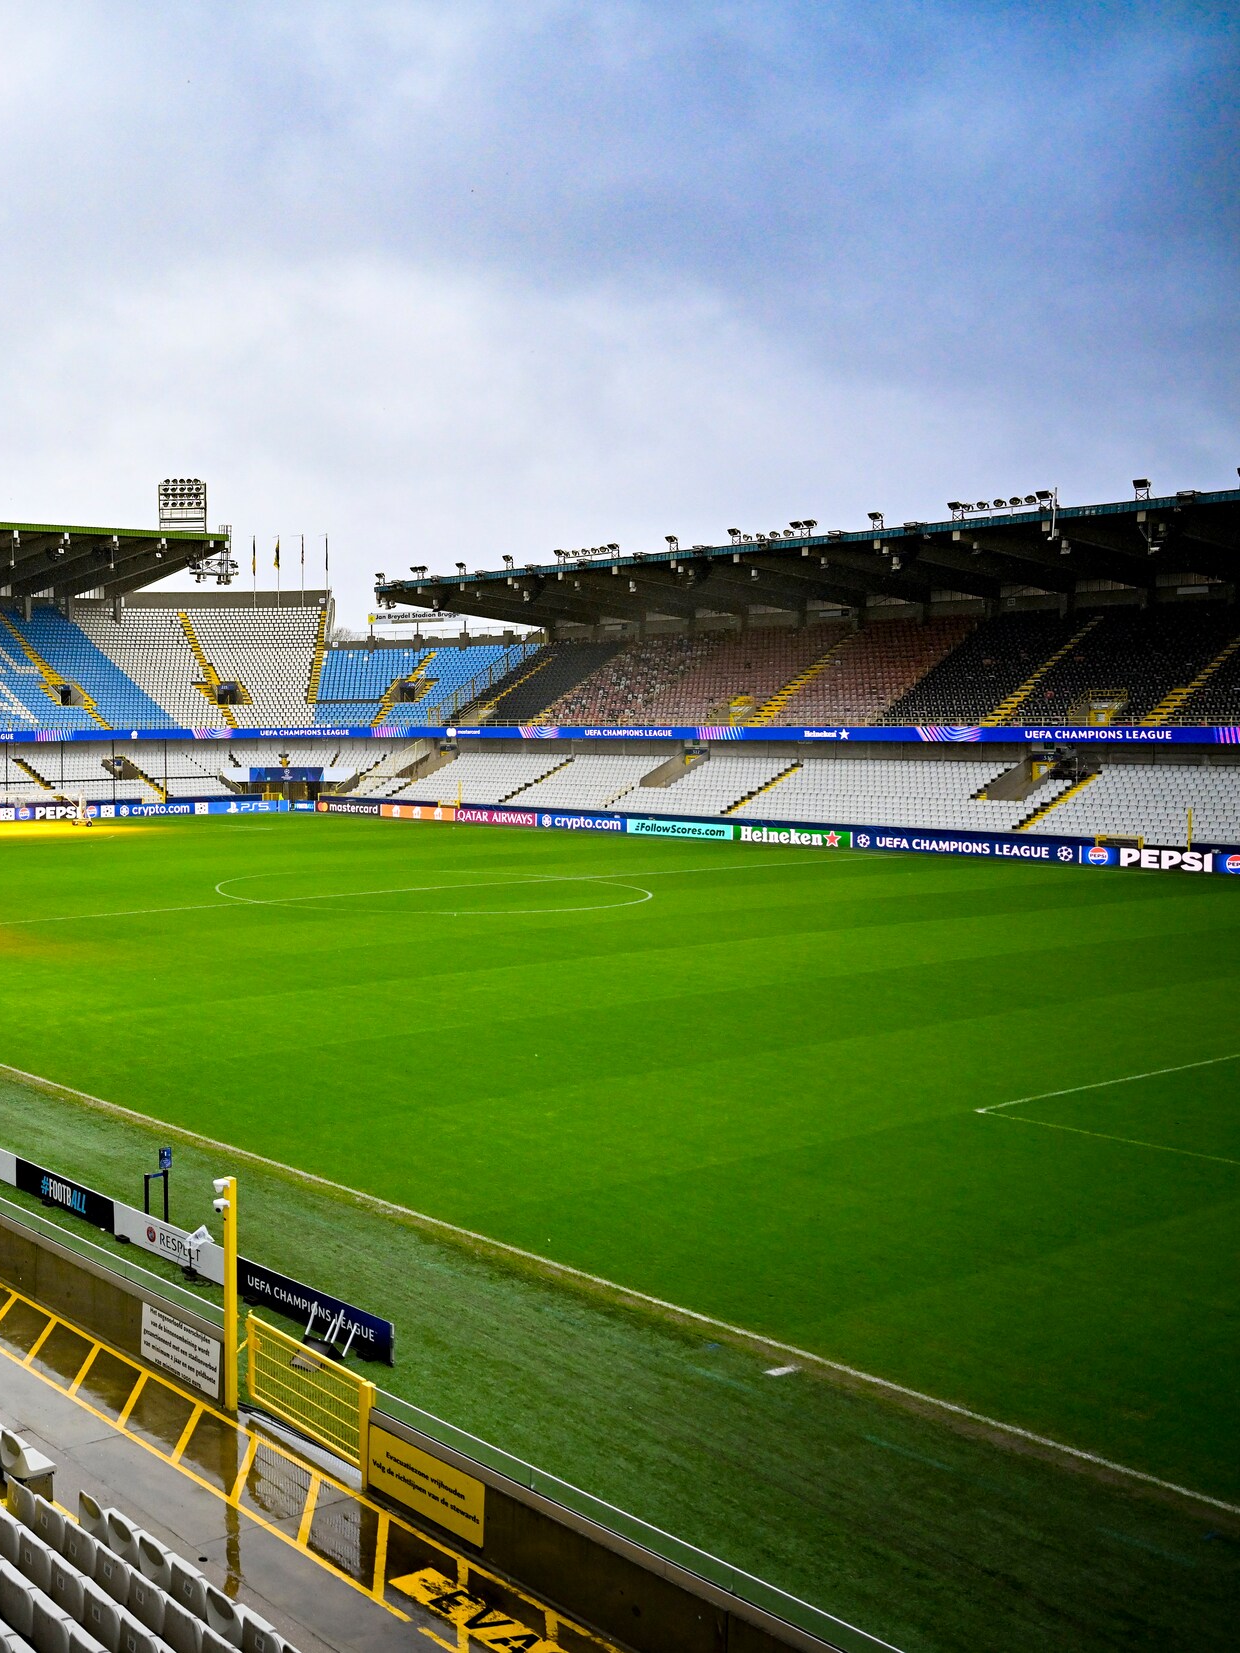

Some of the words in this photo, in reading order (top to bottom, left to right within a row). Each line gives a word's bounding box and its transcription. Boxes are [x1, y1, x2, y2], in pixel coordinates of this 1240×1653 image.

[388, 613, 410, 621] Breydel
[602, 729, 643, 737] CHAMPIONS
[804, 730, 836, 738] Heineken
[1024, 730, 1052, 739] UEFA
[1054, 730, 1123, 740] CHAMPIONS
[1125, 730, 1172, 740] LEAGUE
[131, 802, 190, 817] crypto.com
[240, 802, 270, 811] PS5
[329, 803, 378, 814] mastercard
[457, 810, 489, 822] QATAR
[492, 811, 533, 826] AIRWAYS
[554, 815, 621, 831] crypto.com
[635, 822, 725, 837] FollowScores.com
[740, 826, 823, 846] Heineken
[876, 836, 909, 849] UEFA
[912, 838, 990, 855] CHAMPIONS
[995, 843, 1050, 859] LEAGUE
[1120, 847, 1213, 873] PEPSI
[41, 1176, 86, 1214] #FOOTBALL
[159, 1232, 201, 1262] RESPET
[247, 1274, 272, 1295] UEFA
[273, 1286, 331, 1322] CHAMPIONS
[334, 1313, 375, 1342] LEAGUE
[150, 1320, 158, 1328] van
[158, 1323, 163, 1331] de
[154, 1358, 162, 1366] van
[385, 1451, 429, 1481] Evacuatiezone
[430, 1476, 466, 1501] vrijhouden
[372, 1458, 386, 1474] Volg
[386, 1467, 394, 1477] de
[395, 1473, 427, 1495] richtlijnen
[427, 1491, 439, 1502] van
[440, 1497, 449, 1508] de
[449, 1503, 480, 1525] stewards
